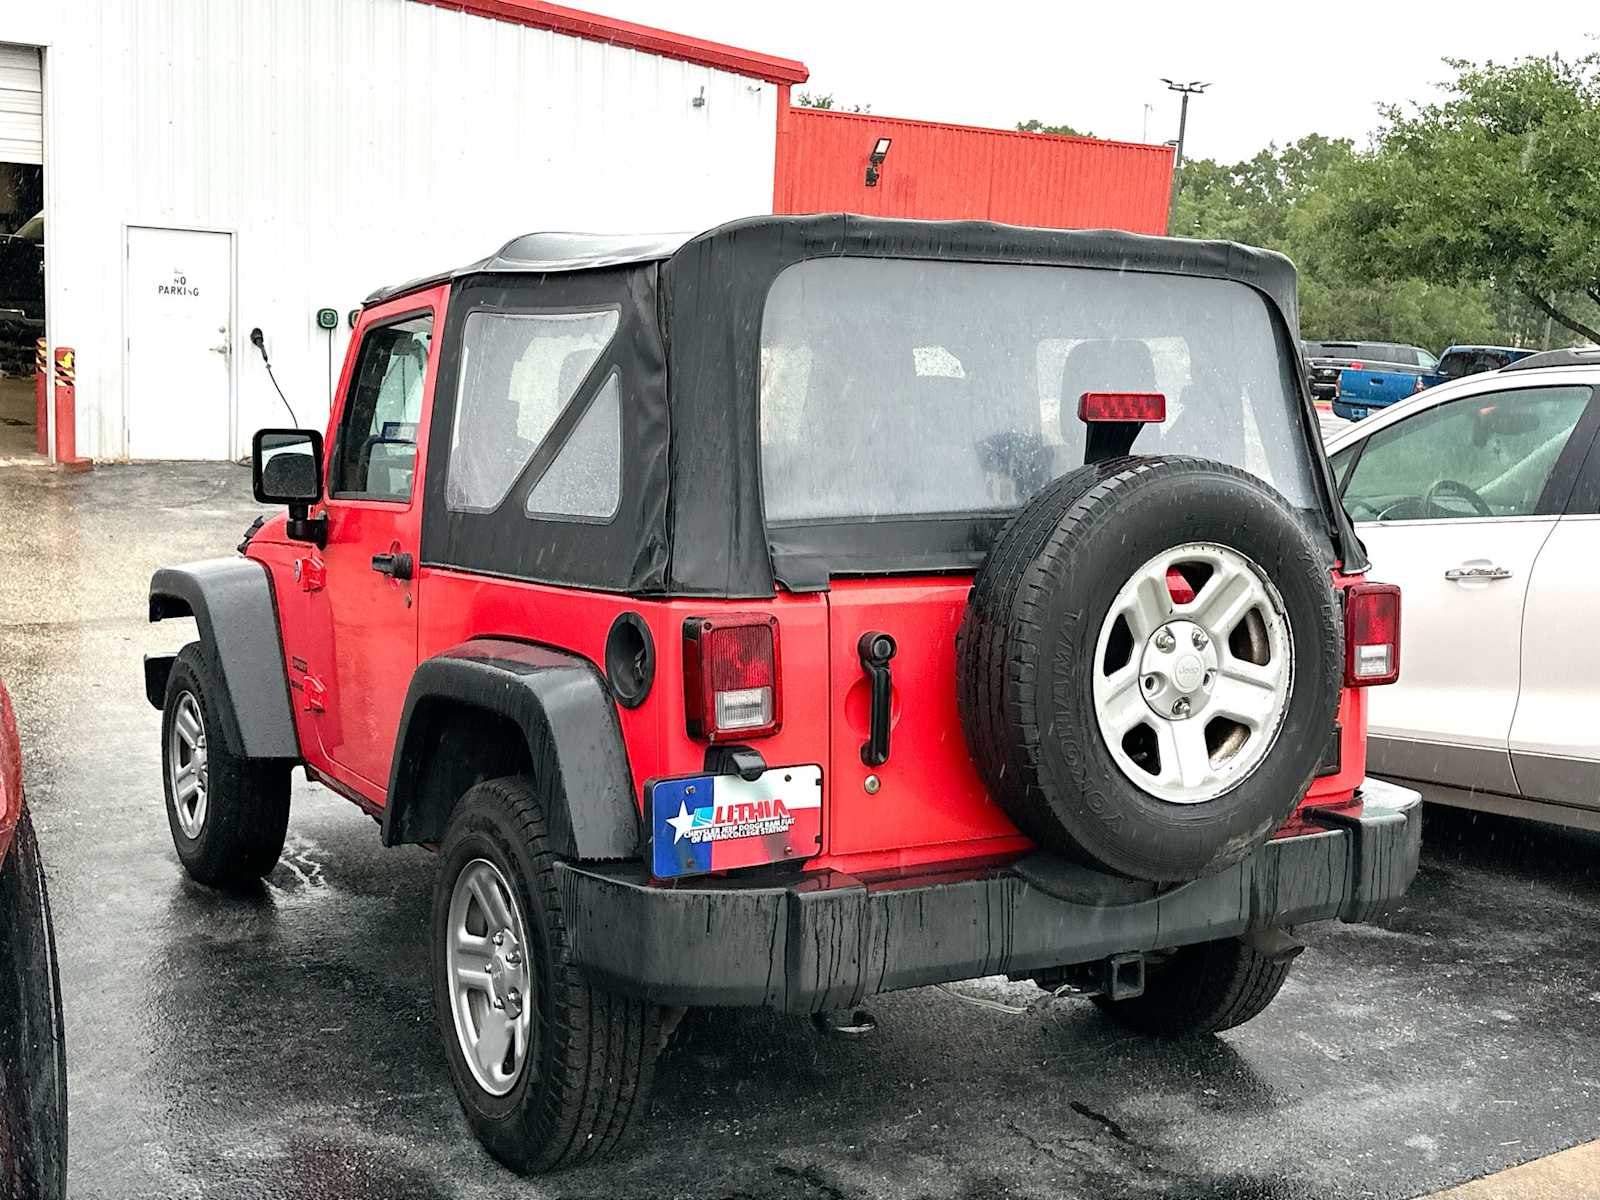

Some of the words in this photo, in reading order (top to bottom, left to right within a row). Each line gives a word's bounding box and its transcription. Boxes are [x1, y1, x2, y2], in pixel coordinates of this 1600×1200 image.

[715, 799, 789, 824] LITHIA
[684, 827, 720, 838] CHRYSLER
[739, 822, 763, 831] DODGE
[764, 819, 780, 828] RAM
[780, 817, 795, 826] FIAT
[691, 836, 701, 844] OF
[762, 825, 789, 835] STATION
